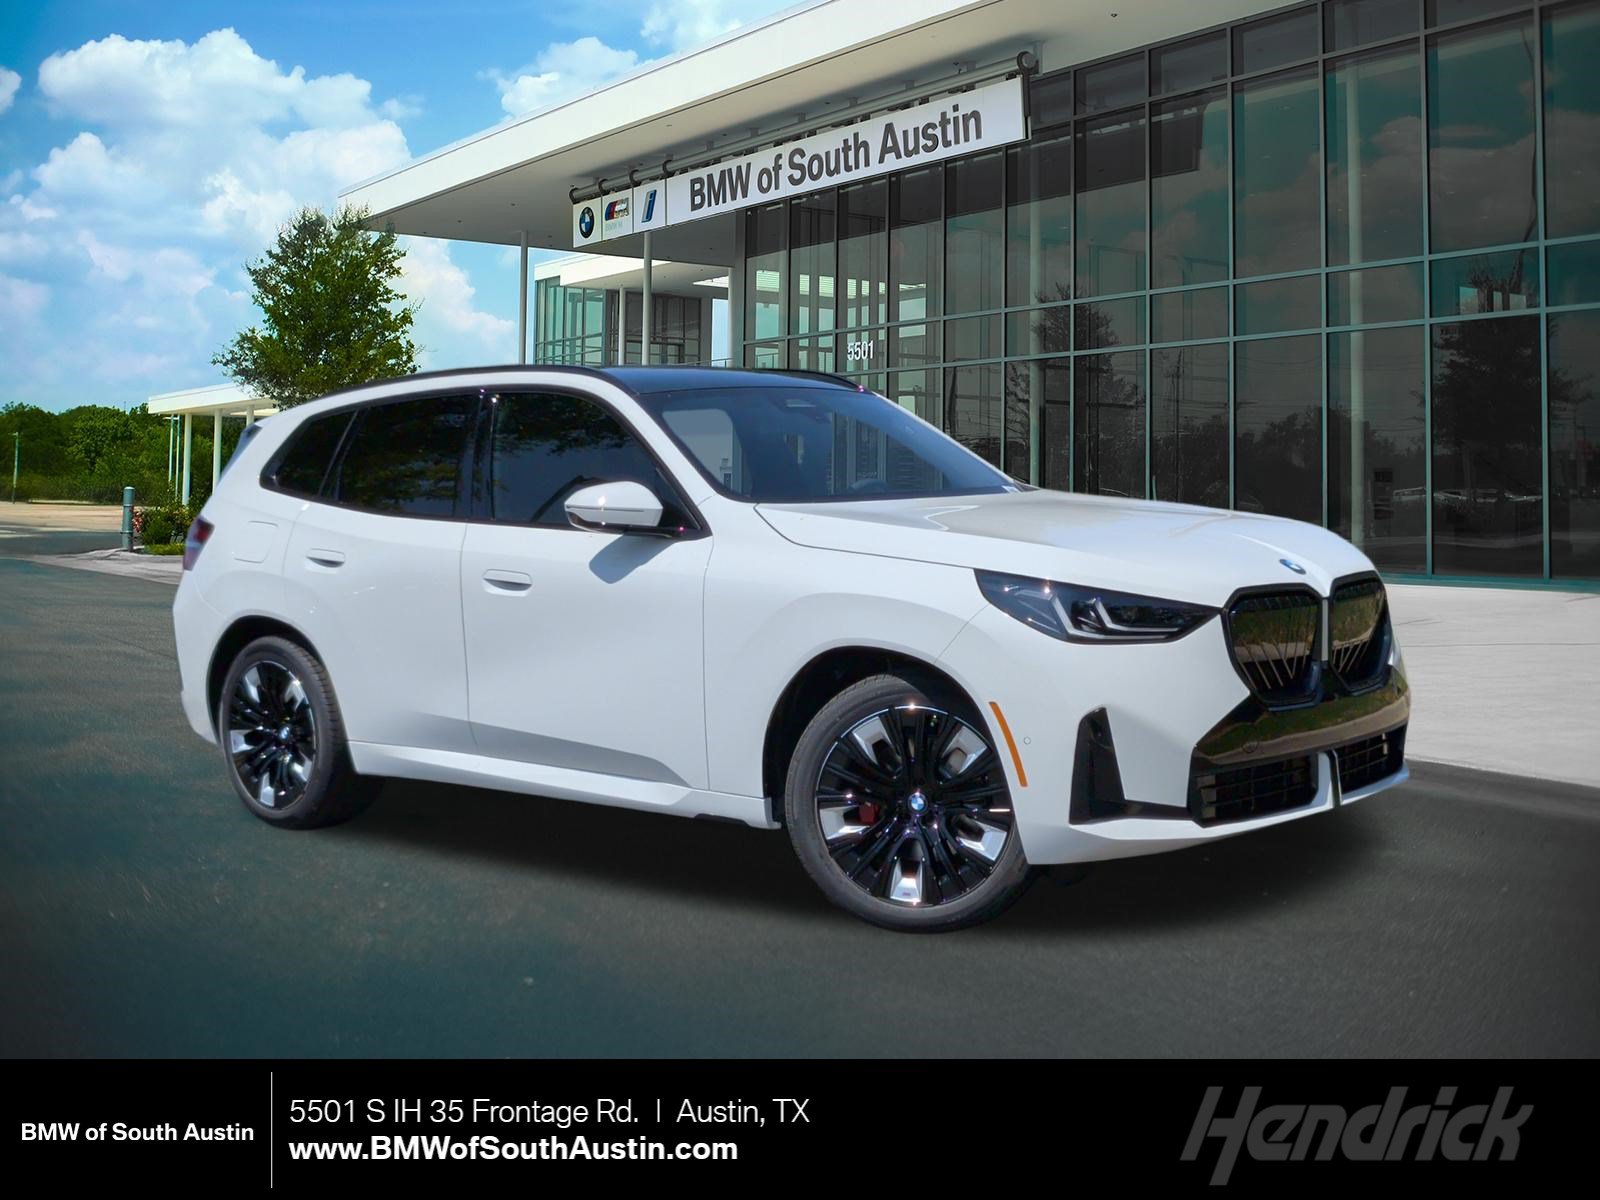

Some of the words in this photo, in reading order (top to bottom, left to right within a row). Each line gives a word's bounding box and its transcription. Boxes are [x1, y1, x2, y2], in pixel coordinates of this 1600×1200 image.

[690, 162, 751, 212] BMW
[757, 153, 783, 194] of
[788, 132, 870, 187] South
[878, 104, 982, 164] Austin
[847, 340, 874, 361] 5501
